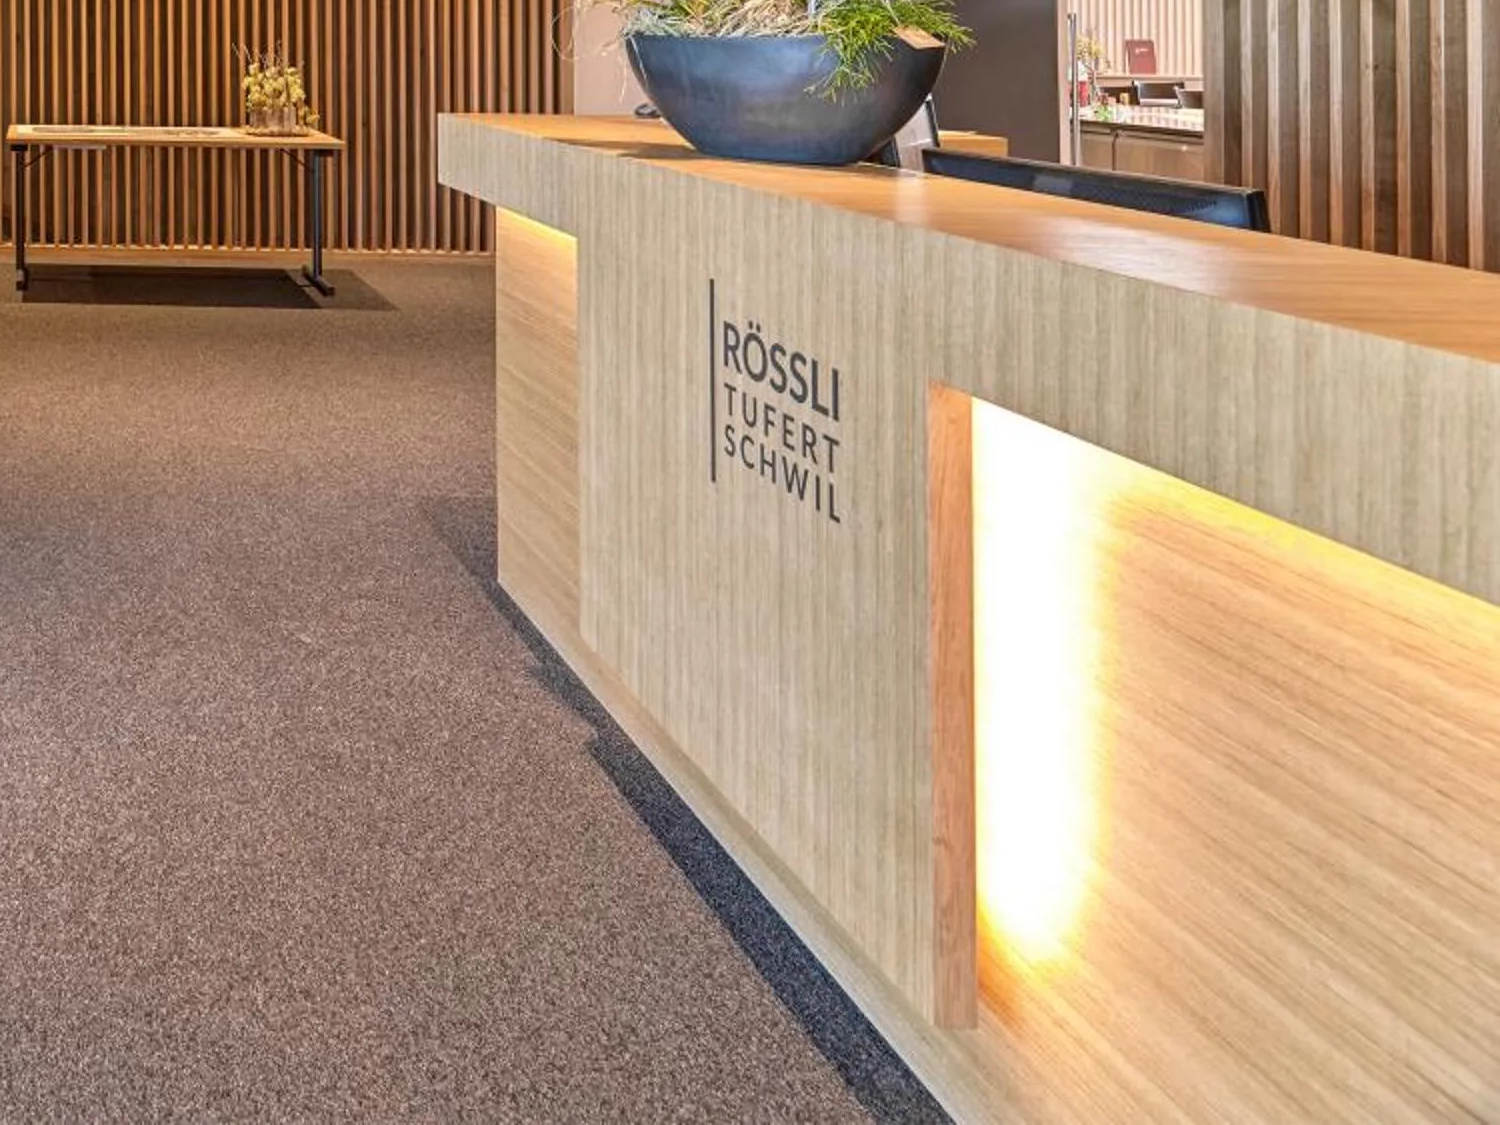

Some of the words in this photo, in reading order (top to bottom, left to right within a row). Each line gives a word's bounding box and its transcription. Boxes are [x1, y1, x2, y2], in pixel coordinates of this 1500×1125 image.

[723, 320, 840, 422] RÖSSLI
[723, 424, 841, 524] SCHWIL
[724, 382, 840, 474] TUFERT
